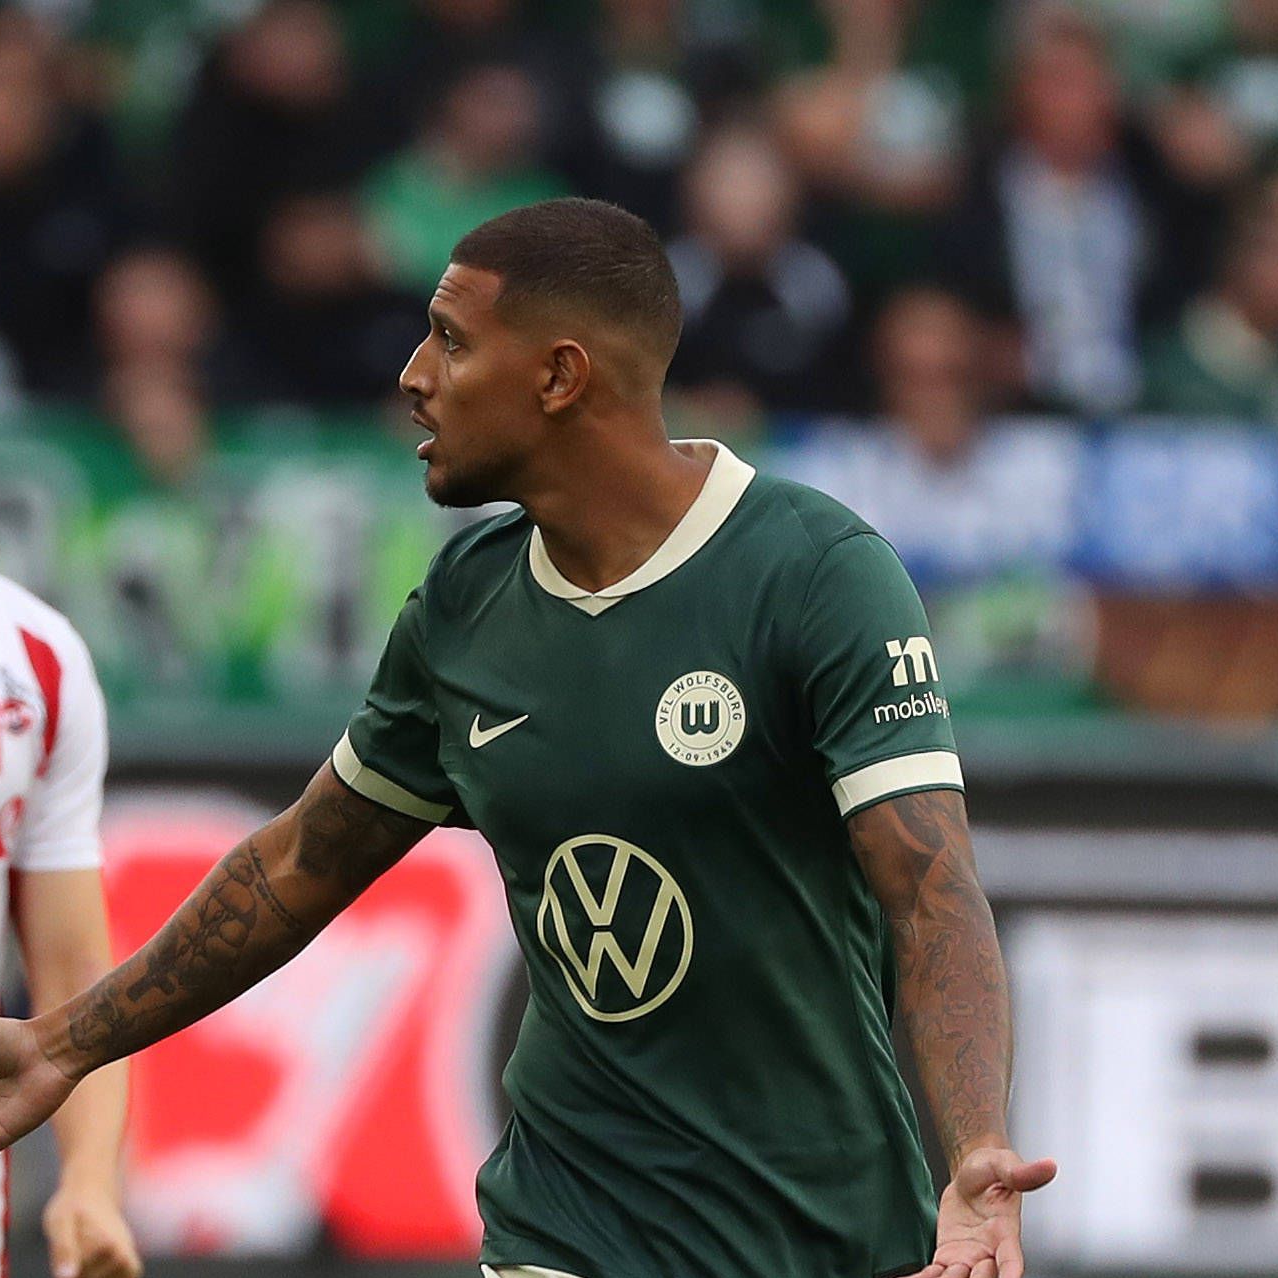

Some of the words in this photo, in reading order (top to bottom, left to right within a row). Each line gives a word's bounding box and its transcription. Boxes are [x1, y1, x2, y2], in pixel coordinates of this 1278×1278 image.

[672, 675, 742, 720] WOLFSBURG
[874, 691, 950, 724] mobile
[668, 740, 733, 762] 12-09-1945
